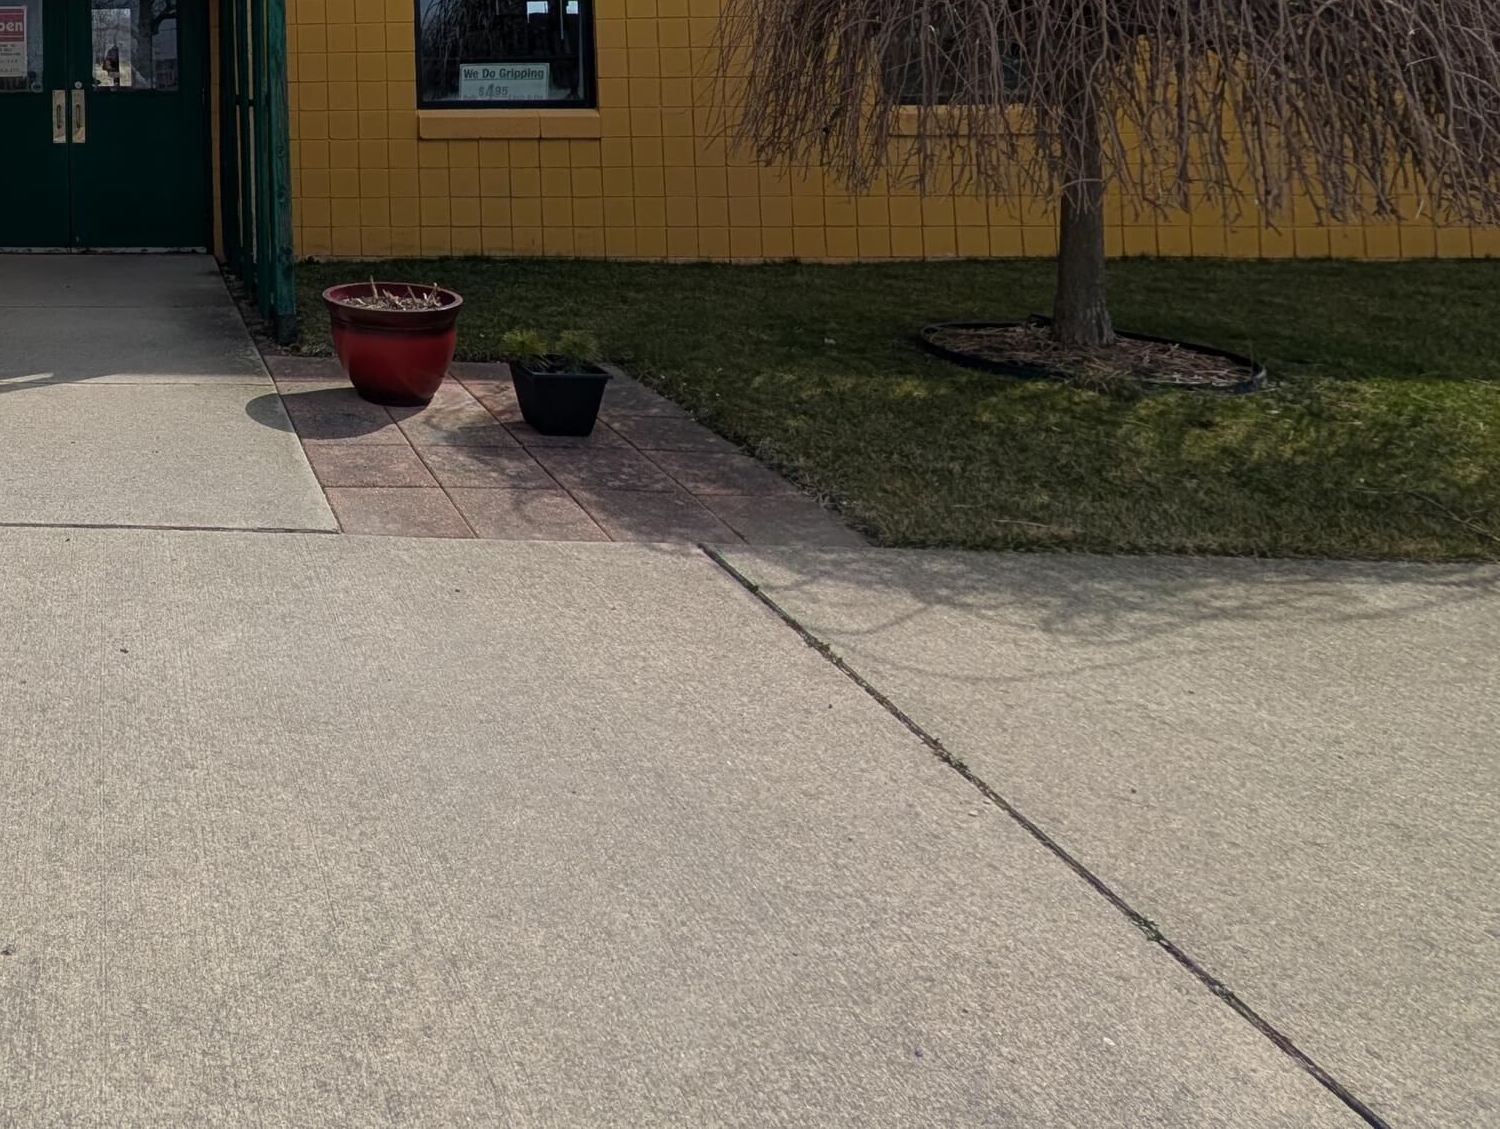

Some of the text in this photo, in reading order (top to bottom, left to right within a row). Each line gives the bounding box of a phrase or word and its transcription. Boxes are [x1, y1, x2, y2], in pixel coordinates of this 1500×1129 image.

[463, 68, 544, 80] We Do Gripping
